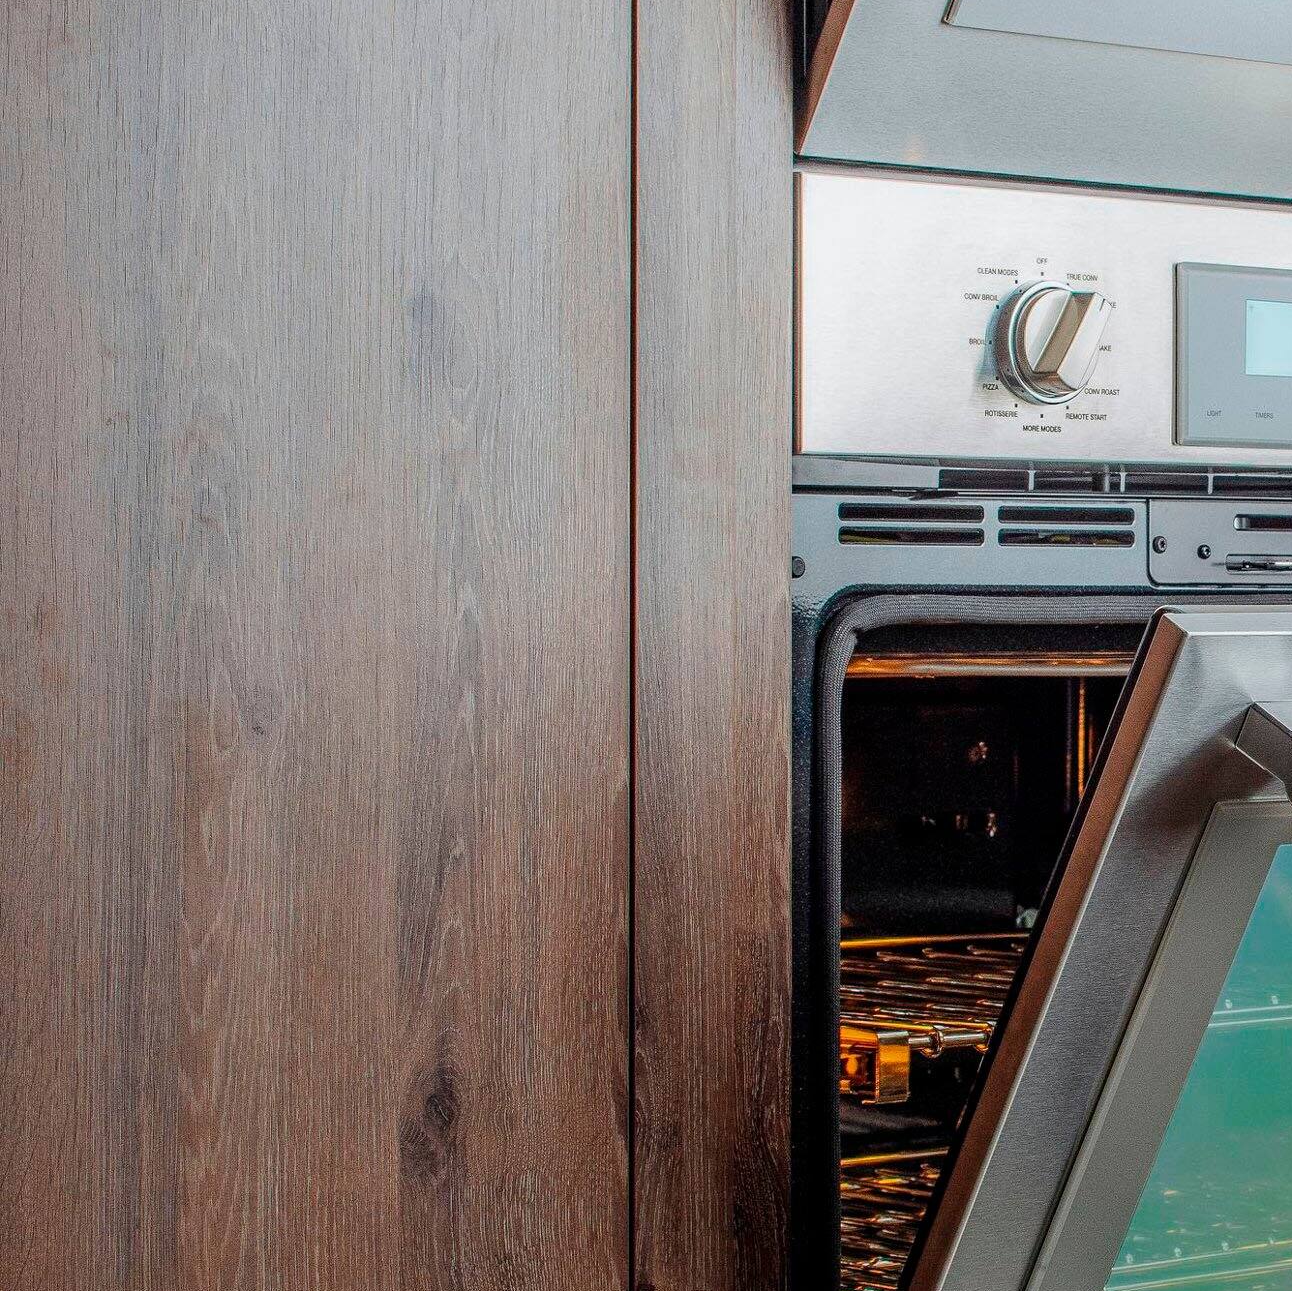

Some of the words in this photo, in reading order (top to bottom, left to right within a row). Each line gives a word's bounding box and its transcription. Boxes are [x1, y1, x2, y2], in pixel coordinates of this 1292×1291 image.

[1036, 257, 1048, 265] OFF
[977, 267, 997, 276] CLEAN
[998, 268, 1019, 277] MODES
[1066, 273, 1081, 281] TRUE
[1082, 274, 1098, 282] CONV
[964, 292, 981, 300] CONV
[982, 294, 999, 302] BROIL
[982, 383, 999, 391] PIZZA
[1084, 387, 1100, 396] CONV
[1101, 388, 1120, 396] ROAST
[984, 409, 1019, 418] ROTISSERIE
[1065, 412, 1089, 421] REMOTE
[1089, 413, 1108, 421] START
[1022, 425, 1040, 433] MORE
[1041, 425, 1062, 434] MODES
